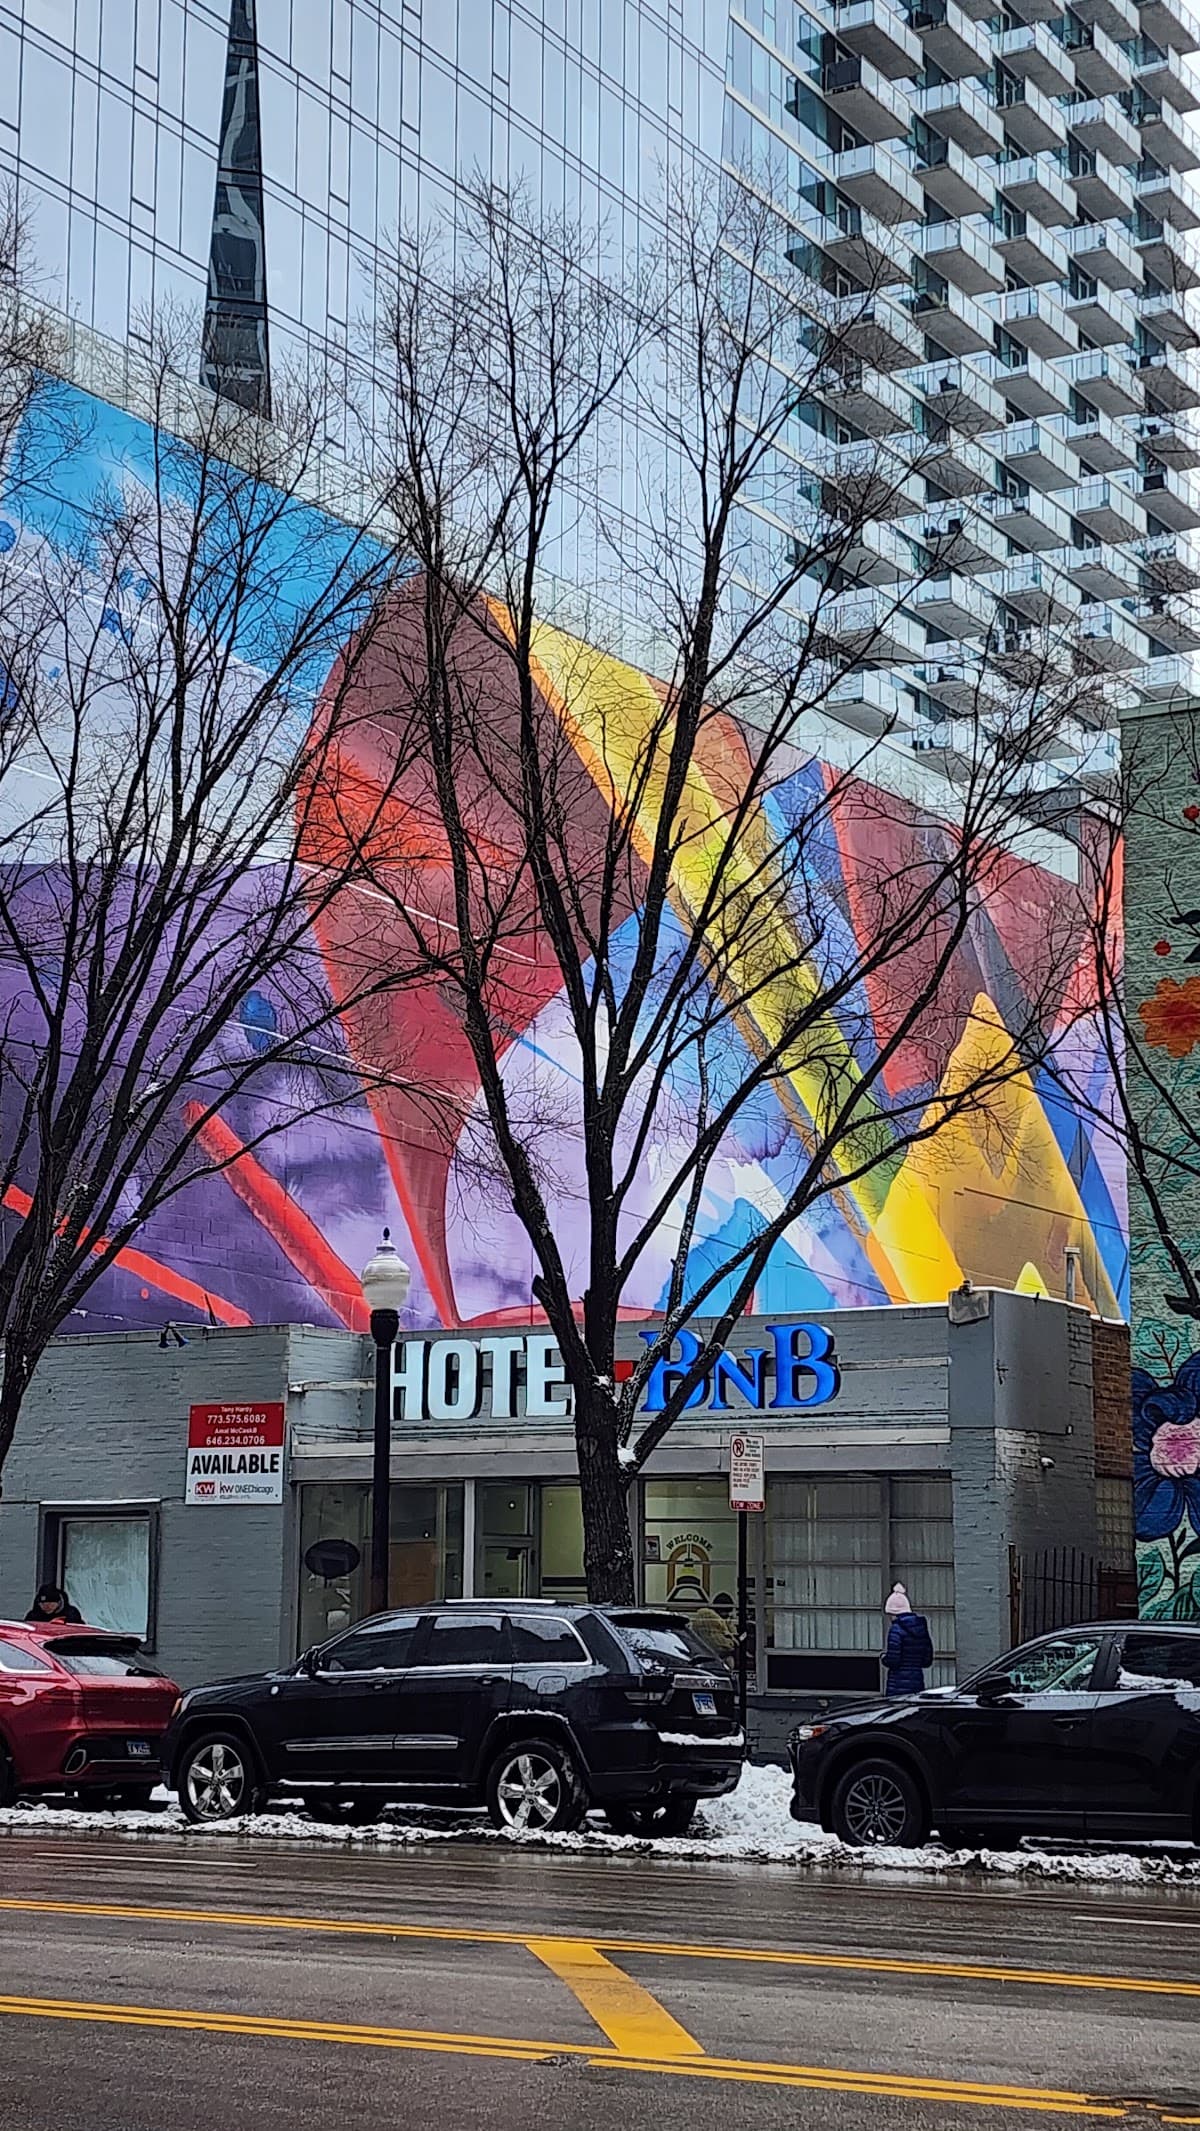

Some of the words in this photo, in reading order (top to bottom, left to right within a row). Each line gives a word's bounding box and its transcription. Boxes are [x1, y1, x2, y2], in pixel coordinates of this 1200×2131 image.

[390, 1334, 575, 1420] HOTE
[207, 1414, 266, 1424] 773.575.6082
[206, 1435, 265, 1445] 646.234.0706
[191, 1453, 280, 1475] AVAILABLE
[195, 1483, 215, 1494] KW
[666, 1533, 713, 1552] WELCOME
